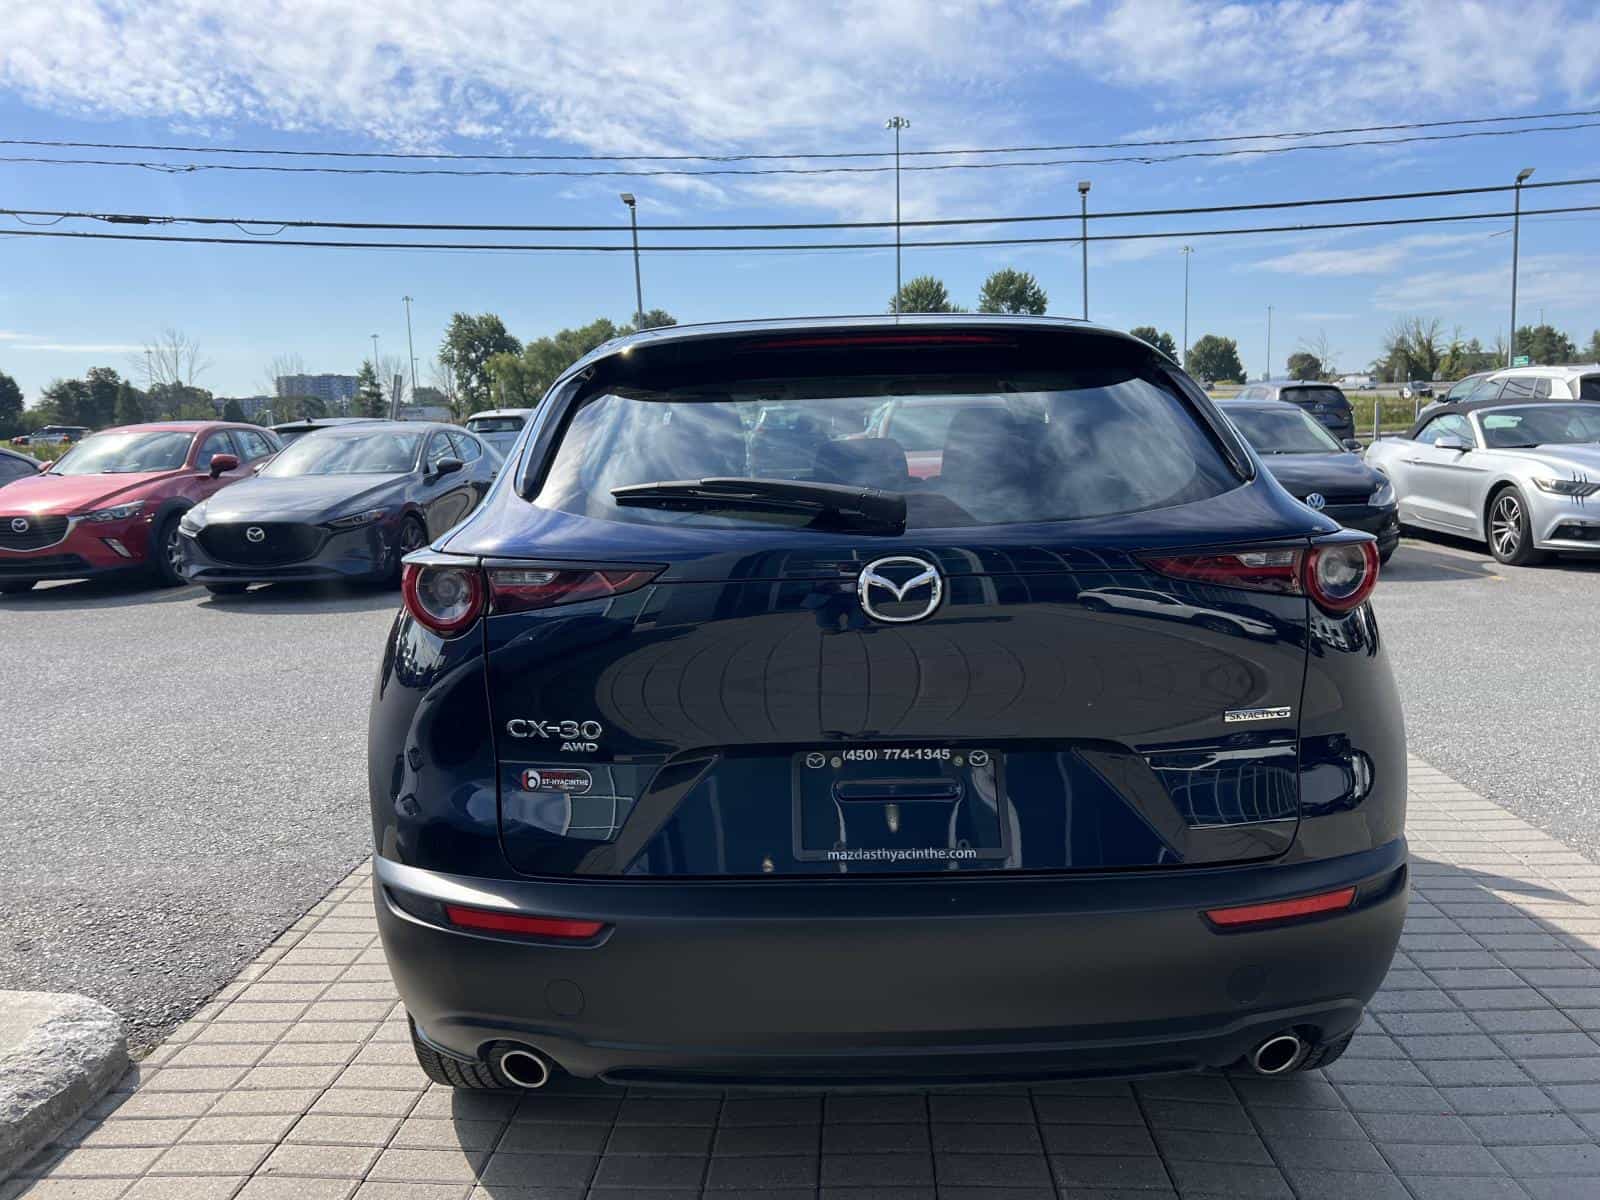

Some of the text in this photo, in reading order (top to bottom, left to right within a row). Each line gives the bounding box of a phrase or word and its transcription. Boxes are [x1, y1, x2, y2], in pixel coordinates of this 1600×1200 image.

[506, 719, 603, 740] CX-30
[560, 742, 599, 752] AWD
[842, 748, 951, 761] (450) 774-1345
[827, 847, 977, 863] mazdasthyacinthe.com
